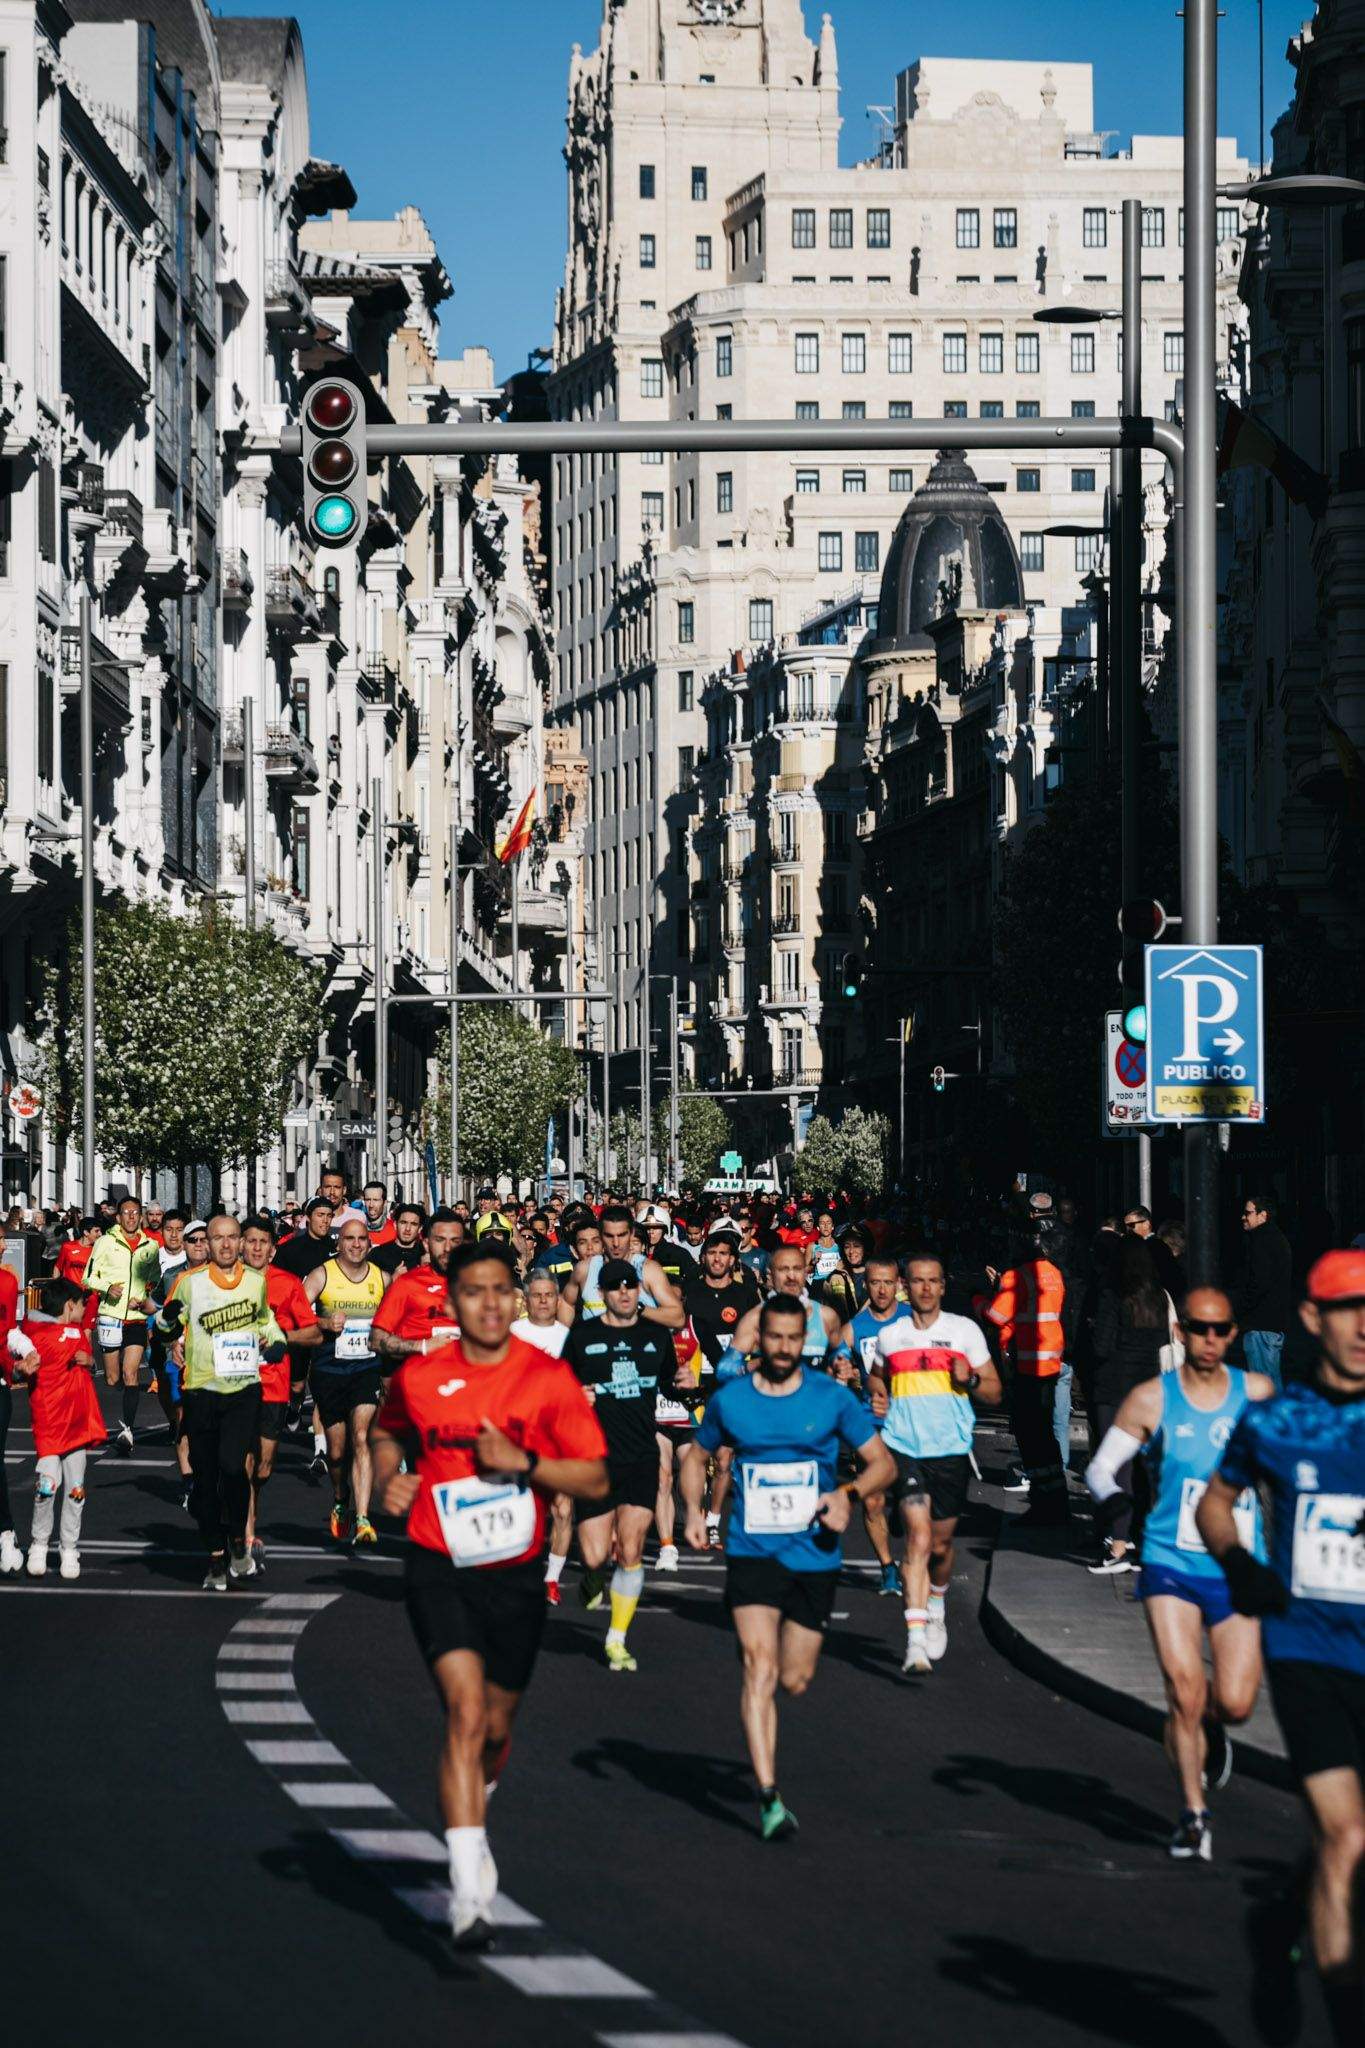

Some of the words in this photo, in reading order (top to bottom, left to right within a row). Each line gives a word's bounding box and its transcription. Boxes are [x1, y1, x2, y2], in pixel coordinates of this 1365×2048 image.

[1171, 974, 1239, 1062] P
[1163, 1064, 1247, 1081] PUBLICO
[1116, 1092, 1134, 1100] TODO
[1136, 1091, 1147, 1099] TIP
[1161, 1095, 1200, 1105] PLAZA
[1225, 1095, 1249, 1105] REY
[202, 1302, 253, 1328] TORTUGAS
[227, 1350, 250, 1361] 442
[471, 1507, 514, 1535] 179
